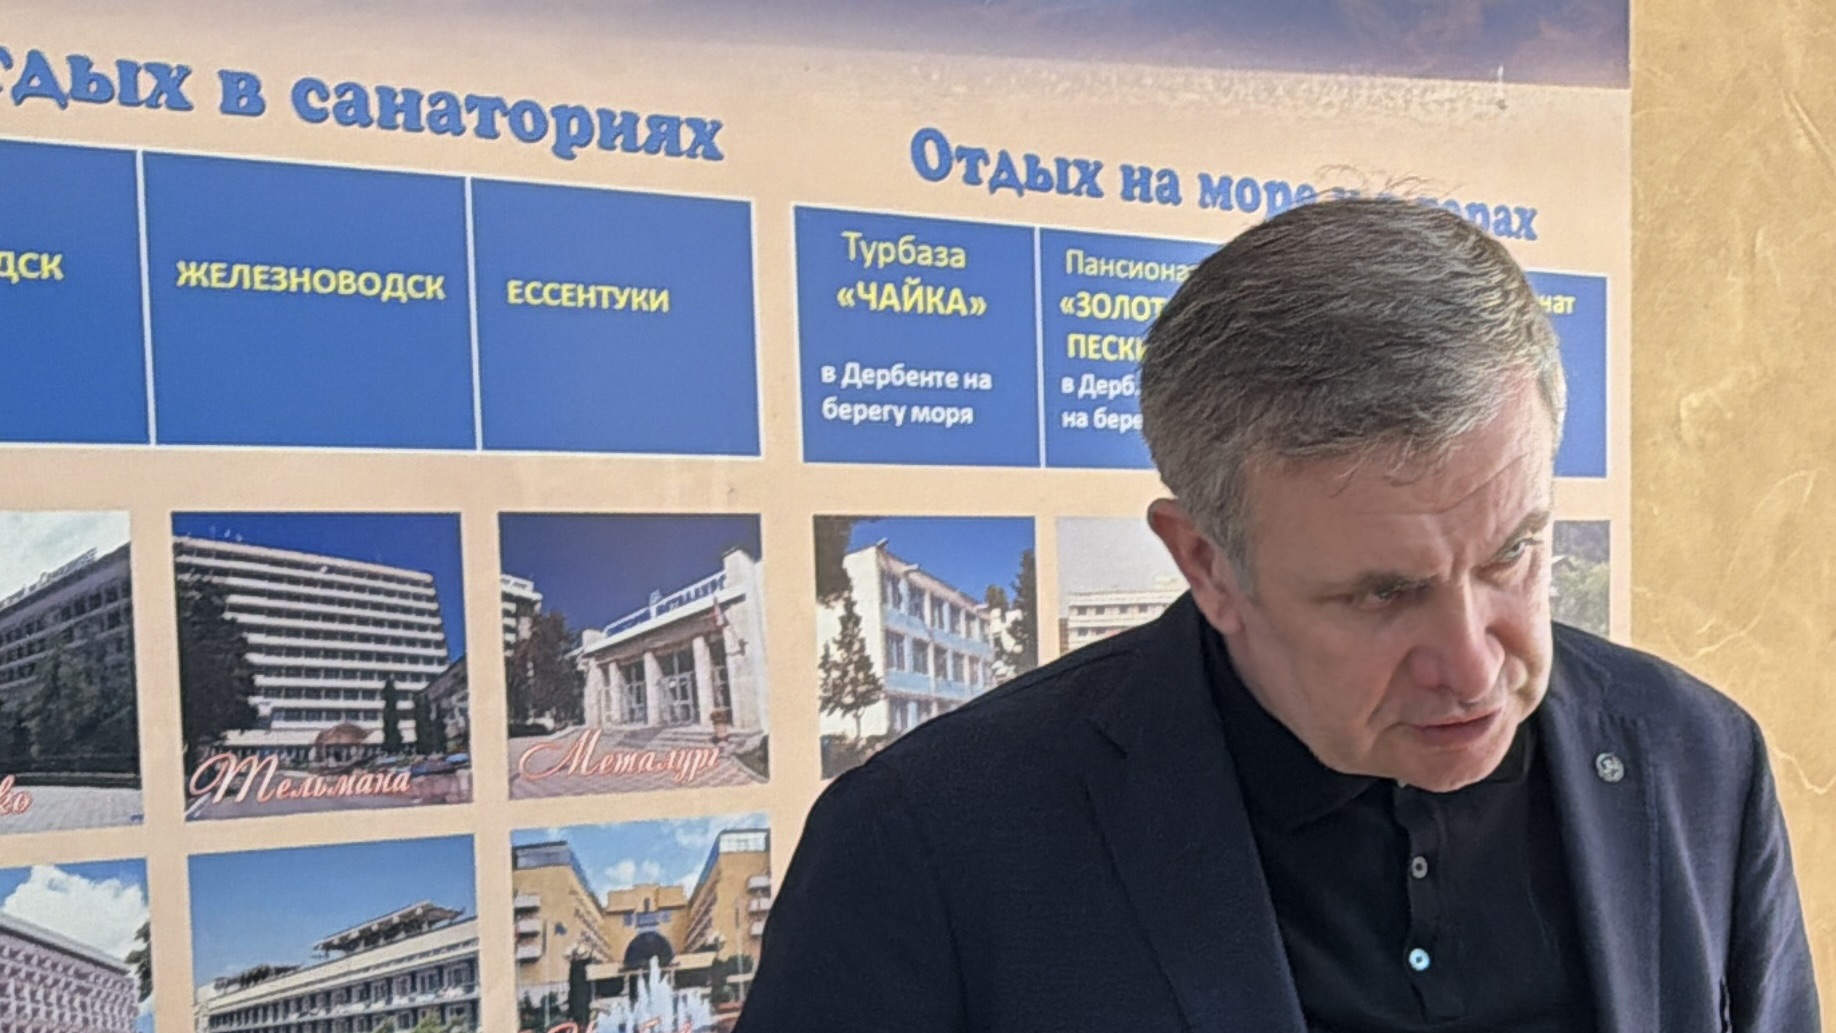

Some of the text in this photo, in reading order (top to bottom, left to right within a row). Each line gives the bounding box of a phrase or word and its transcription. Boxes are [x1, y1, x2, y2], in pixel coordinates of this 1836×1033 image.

[218, 68, 265, 117] в
[290, 77, 725, 161] санаториях
[910, 127, 1105, 198] Отдых
[1119, 162, 1183, 206] на
[841, 230, 967, 269] Турбаза
[1065, 249, 1200, 283] Пансиона
[177, 260, 446, 302] ЖЕЛЕЗНОВОДСК
[507, 280, 670, 313] ЕССЕНТУКИ
[836, 277, 988, 318] «ЧАЙКА»
[1059, 291, 1170, 322] «ЗОЛОТ
[821, 361, 992, 391] в Дербенте на
[1061, 376, 1074, 393] в
[822, 396, 974, 426] берегу моря
[1061, 406, 1143, 434] на бере
[189, 752, 411, 804] Тельмана
